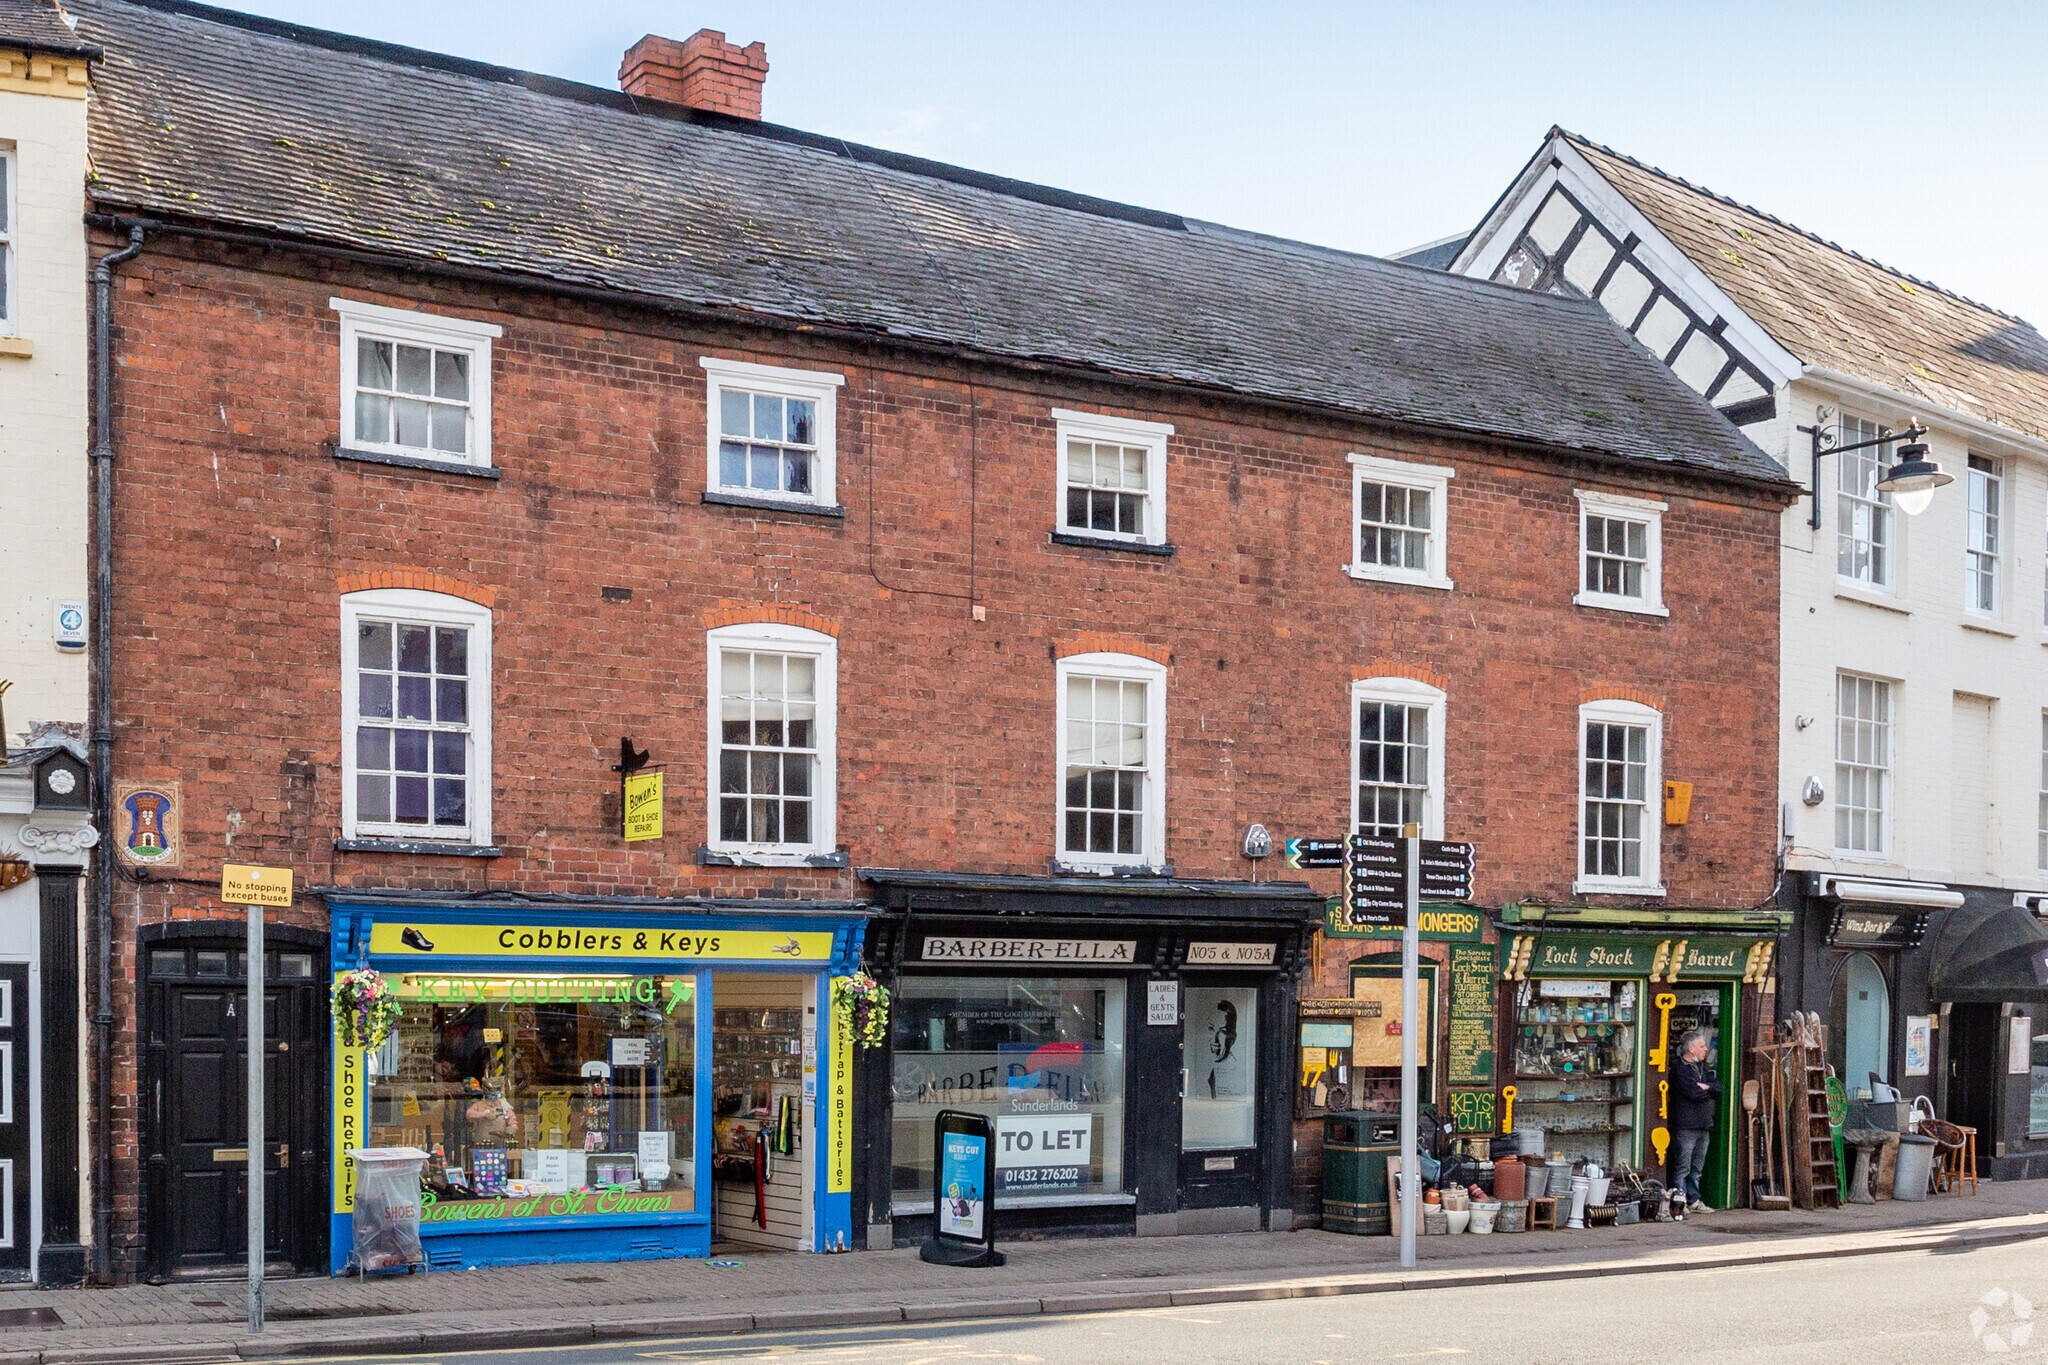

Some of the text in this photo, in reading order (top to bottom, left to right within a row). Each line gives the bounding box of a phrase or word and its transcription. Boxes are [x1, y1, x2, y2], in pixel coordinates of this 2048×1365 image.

[630, 782, 657, 809] Bowen's
[628, 812, 658, 824] BOOT & SHOE
[634, 824, 652, 832] REPAIRS
[126, 848, 136, 858] BEST
[159, 848, 170, 858] WEST
[228, 881, 286, 894] No stopping
[226, 892, 288, 902] except buses
[1864, 921, 1878, 932] Bar
[498, 929, 721, 954] Cobblers & Keys
[926, 940, 1128, 959] BARBER-ELLA
[1221, 948, 1230, 959] &
[1542, 946, 1634, 967] Lock Stock
[1685, 949, 1735, 970] Barrel
[1452, 961, 1494, 973] Lock Stock
[1455, 972, 1490, 984] & Barrel
[417, 978, 657, 1004] KEY CUTTING
[227, 1004, 236, 1016] A
[343, 1055, 355, 1108] Shoe
[836, 1085, 845, 1095] &
[1012, 1098, 1078, 1112] Sunderlands
[1454, 1093, 1491, 1111] KEYS
[1458, 1112, 1485, 1129] CUT
[836, 1099, 845, 1186] Batteries
[1001, 1130, 1087, 1151] TO LET
[949, 1144, 979, 1154] KEYS CUT
[343, 1115, 355, 1206] Repairs
[1006, 1168, 1078, 1181] 01432 276202
[1006, 1181, 1077, 1190] www.sunderlands.co.uk
[420, 1185, 672, 1222] Bowen's of St. Owens
[384, 1206, 415, 1219] SHOES
